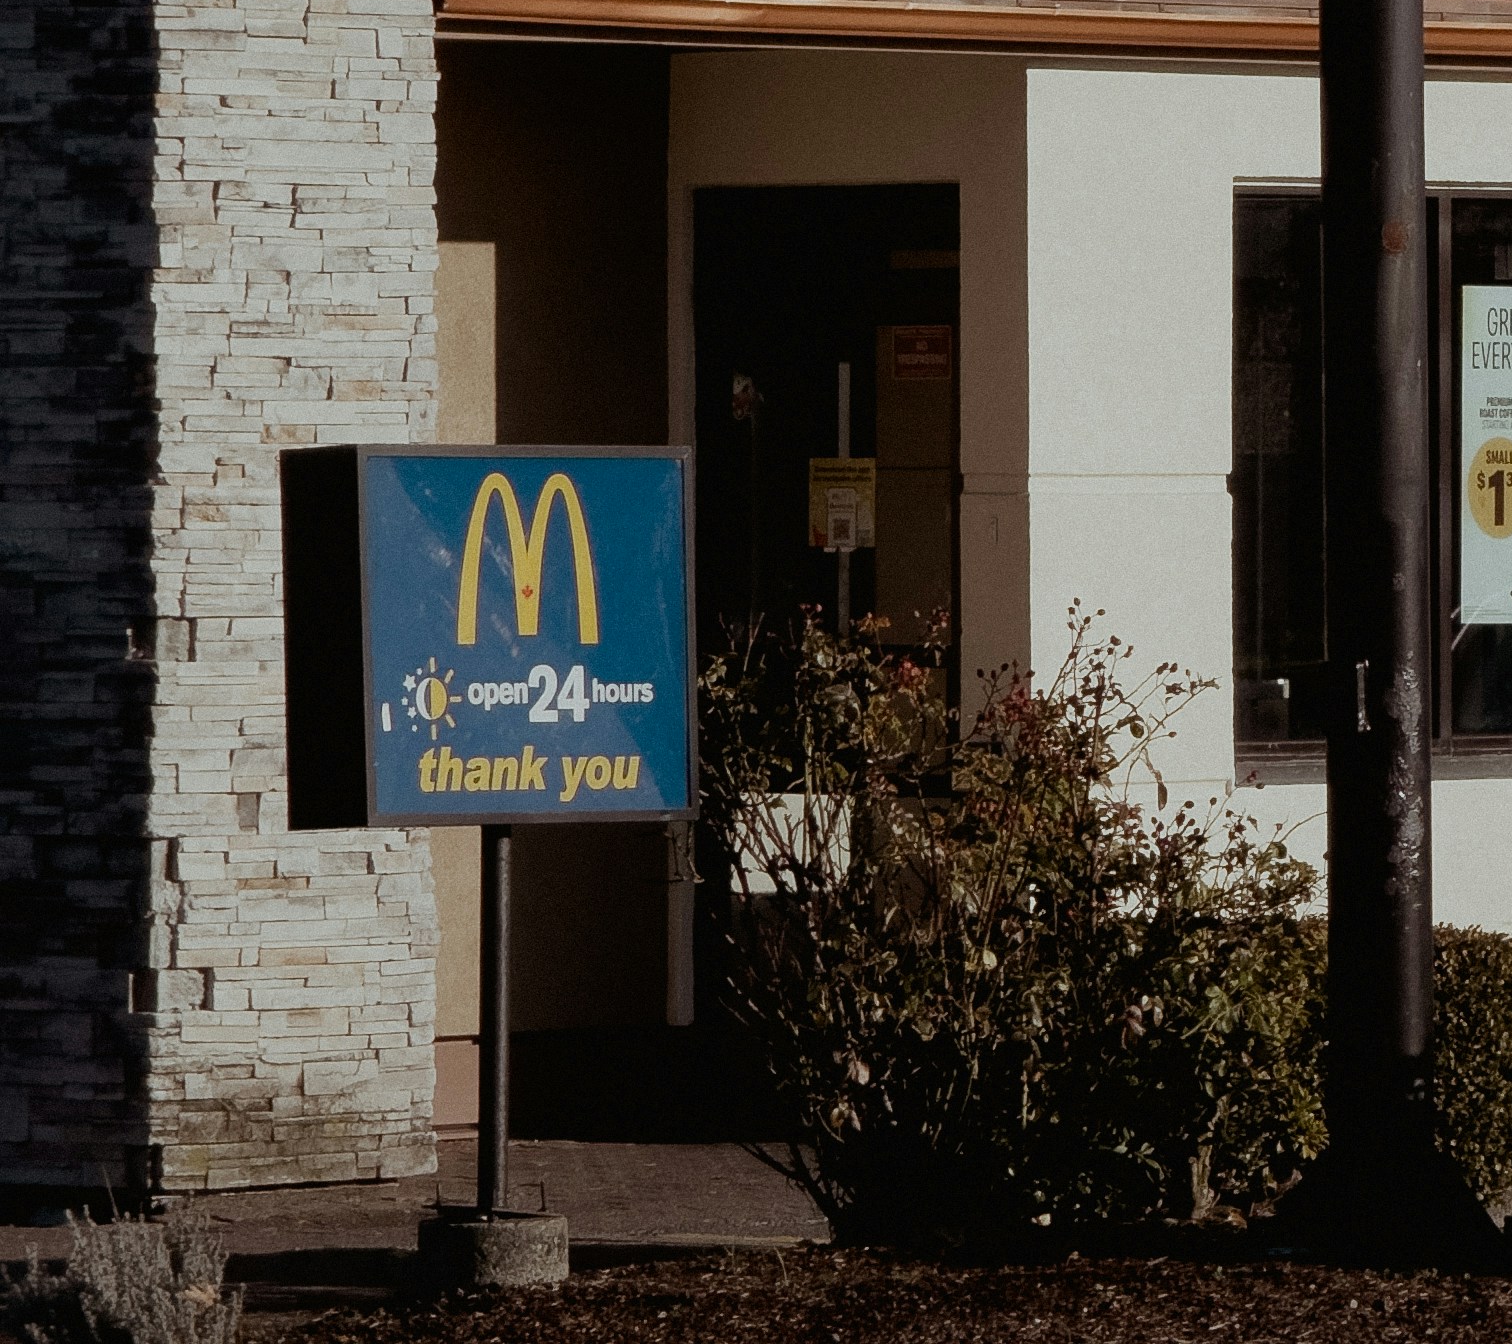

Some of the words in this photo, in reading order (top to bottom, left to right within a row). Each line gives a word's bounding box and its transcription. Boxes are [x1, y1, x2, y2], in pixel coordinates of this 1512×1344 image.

[467, 678, 529, 711] open
[528, 664, 590, 723] 24
[591, 677, 655, 704] hours
[418, 744, 548, 794] thank
[559, 755, 641, 803] you
